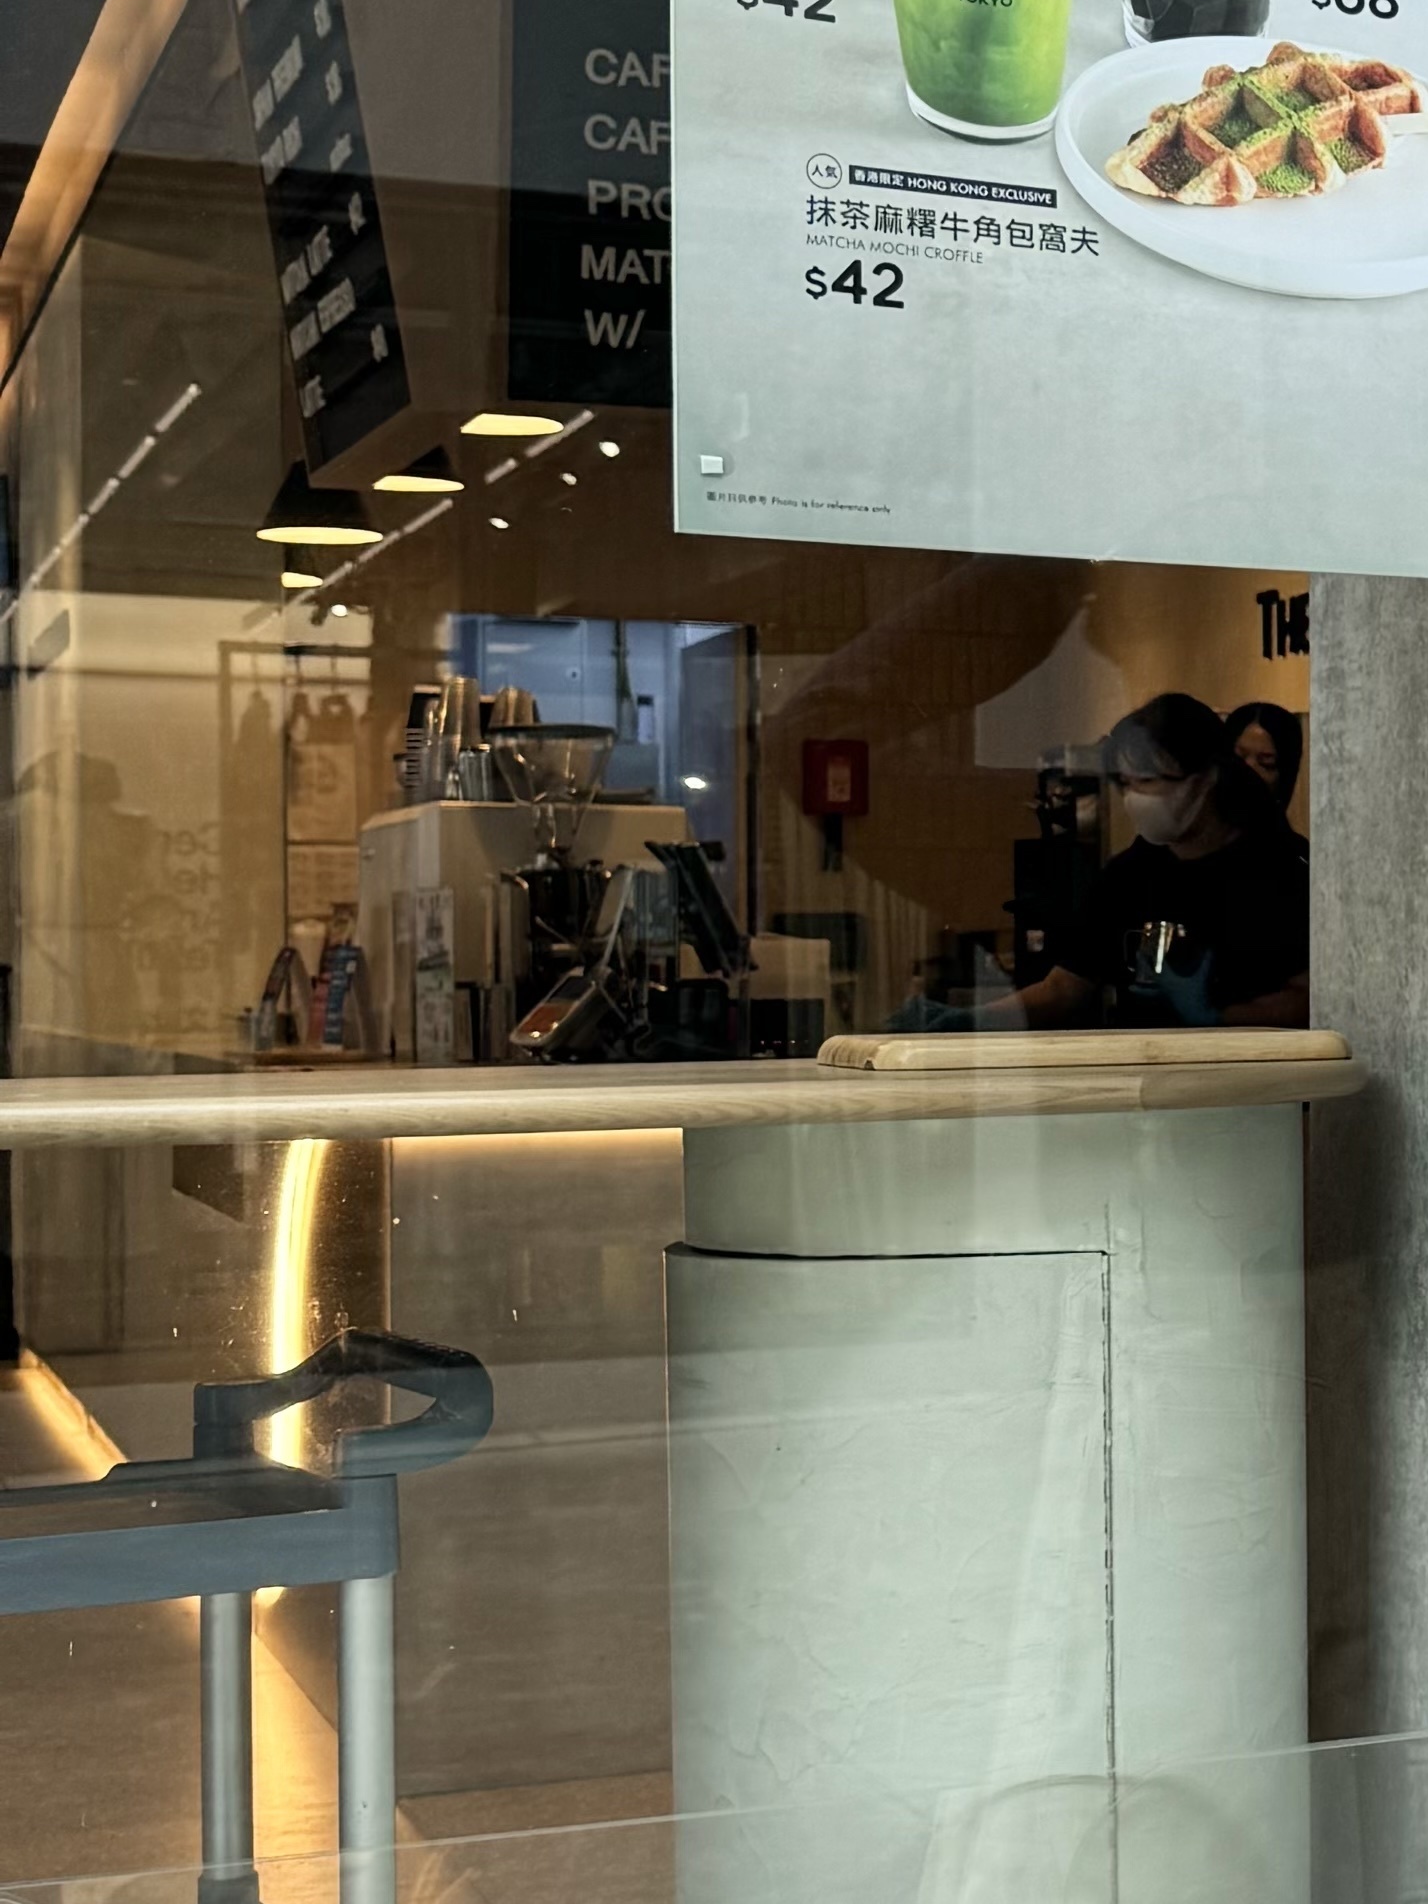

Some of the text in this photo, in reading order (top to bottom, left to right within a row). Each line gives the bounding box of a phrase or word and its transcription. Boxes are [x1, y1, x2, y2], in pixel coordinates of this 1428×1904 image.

[811, 165, 839, 179] 人氣
[854, 169, 1053, 205] 香港限定 HONG KONG EXCLUSIVE
[806, 194, 1100, 257] 抹茶麻糬牛角包窩夫
[806, 234, 984, 264] MATCHA MOCHI CROFFLE
[805, 259, 904, 309] $42
[584, 308, 646, 349] W/
[810, 499, 824, 509] for
[872, 505, 891, 514] only
[1256, 589, 1310, 661] THE
